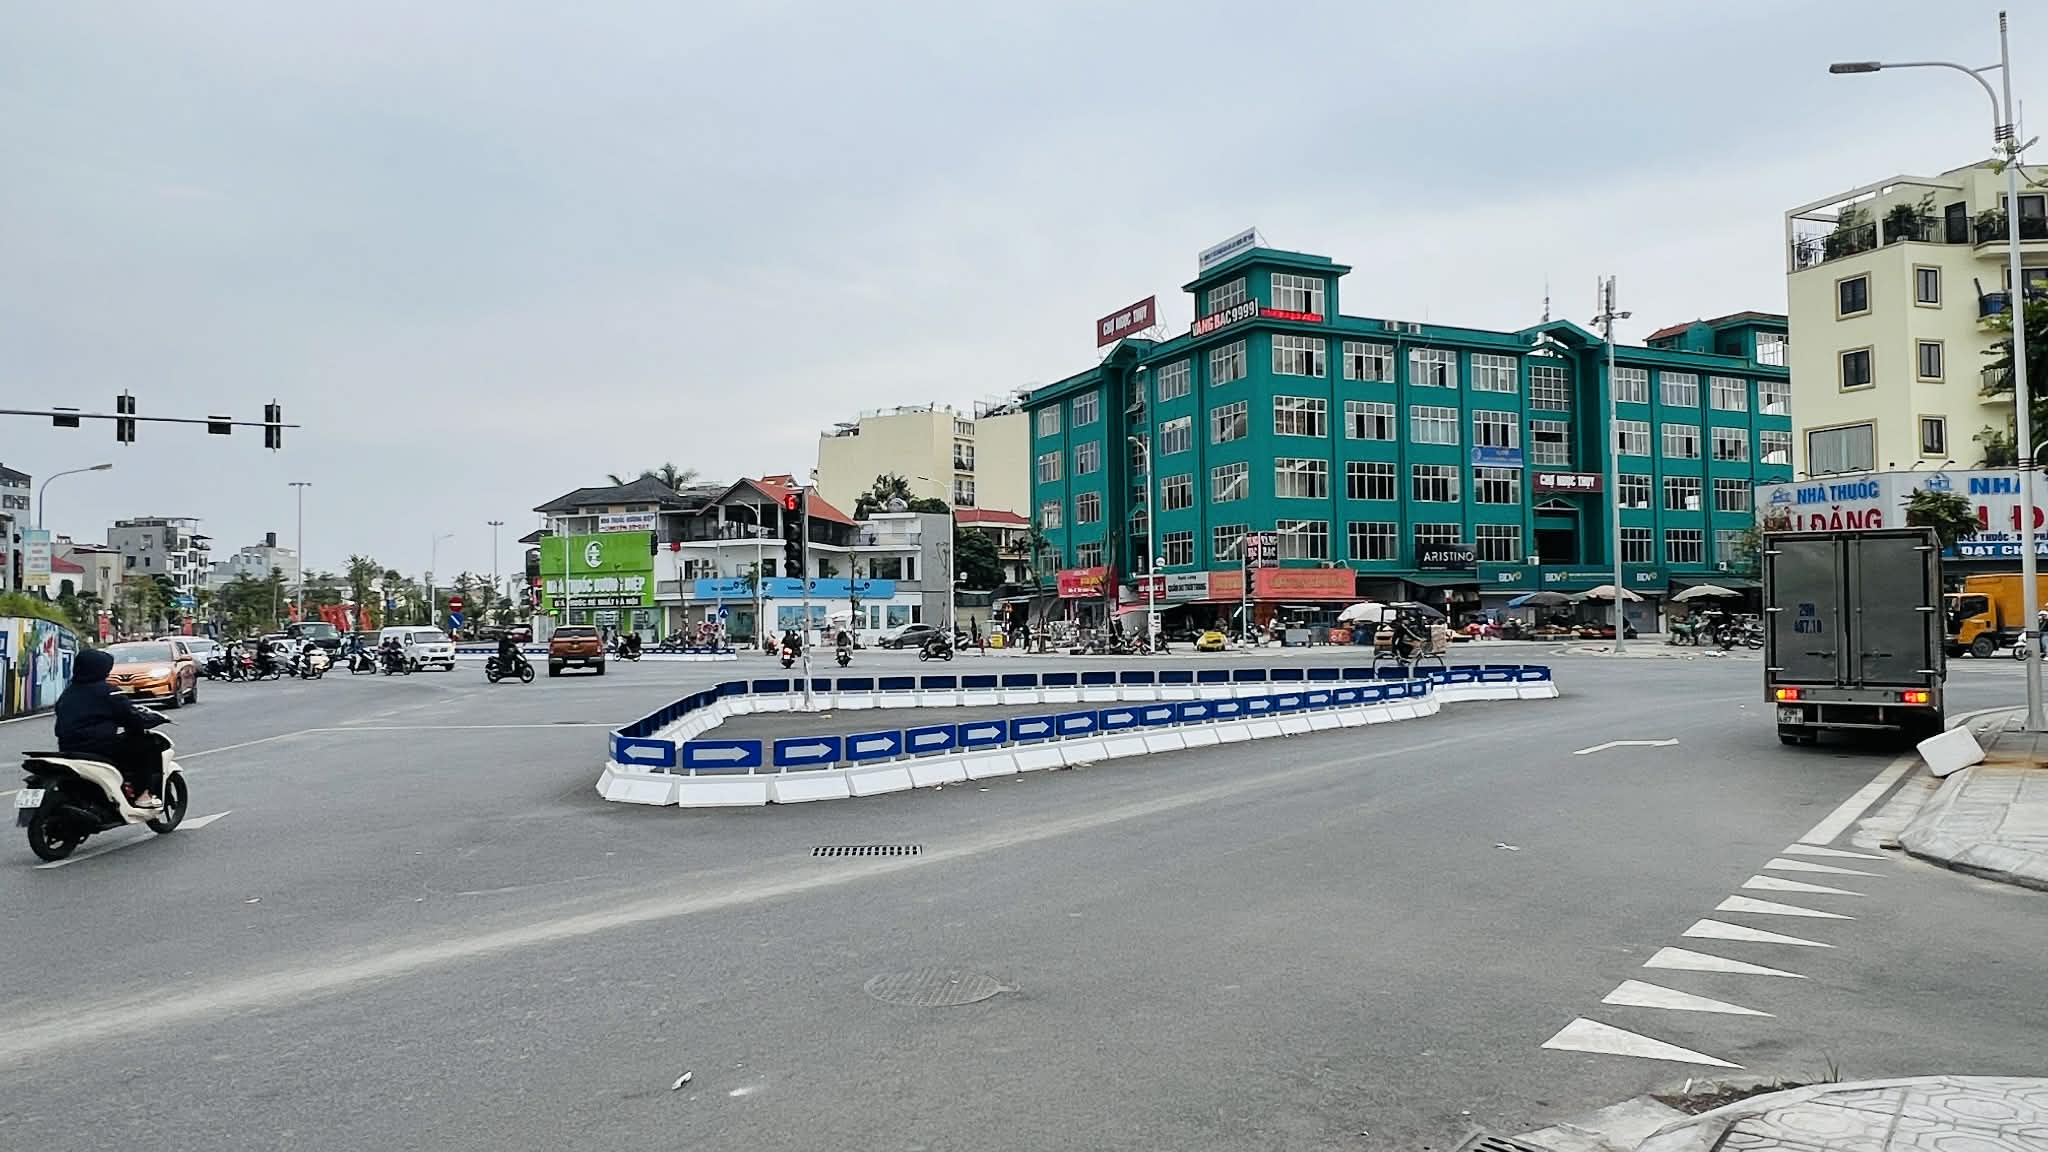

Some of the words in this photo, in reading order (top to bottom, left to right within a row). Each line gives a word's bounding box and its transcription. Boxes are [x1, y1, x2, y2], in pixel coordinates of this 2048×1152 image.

[1797, 483, 1827, 504] NHÀ
[1829, 477, 1880, 501] THUỐC
[1810, 505, 1882, 530] ĐĂNG
[1424, 551, 1474, 561] ARISTINO
